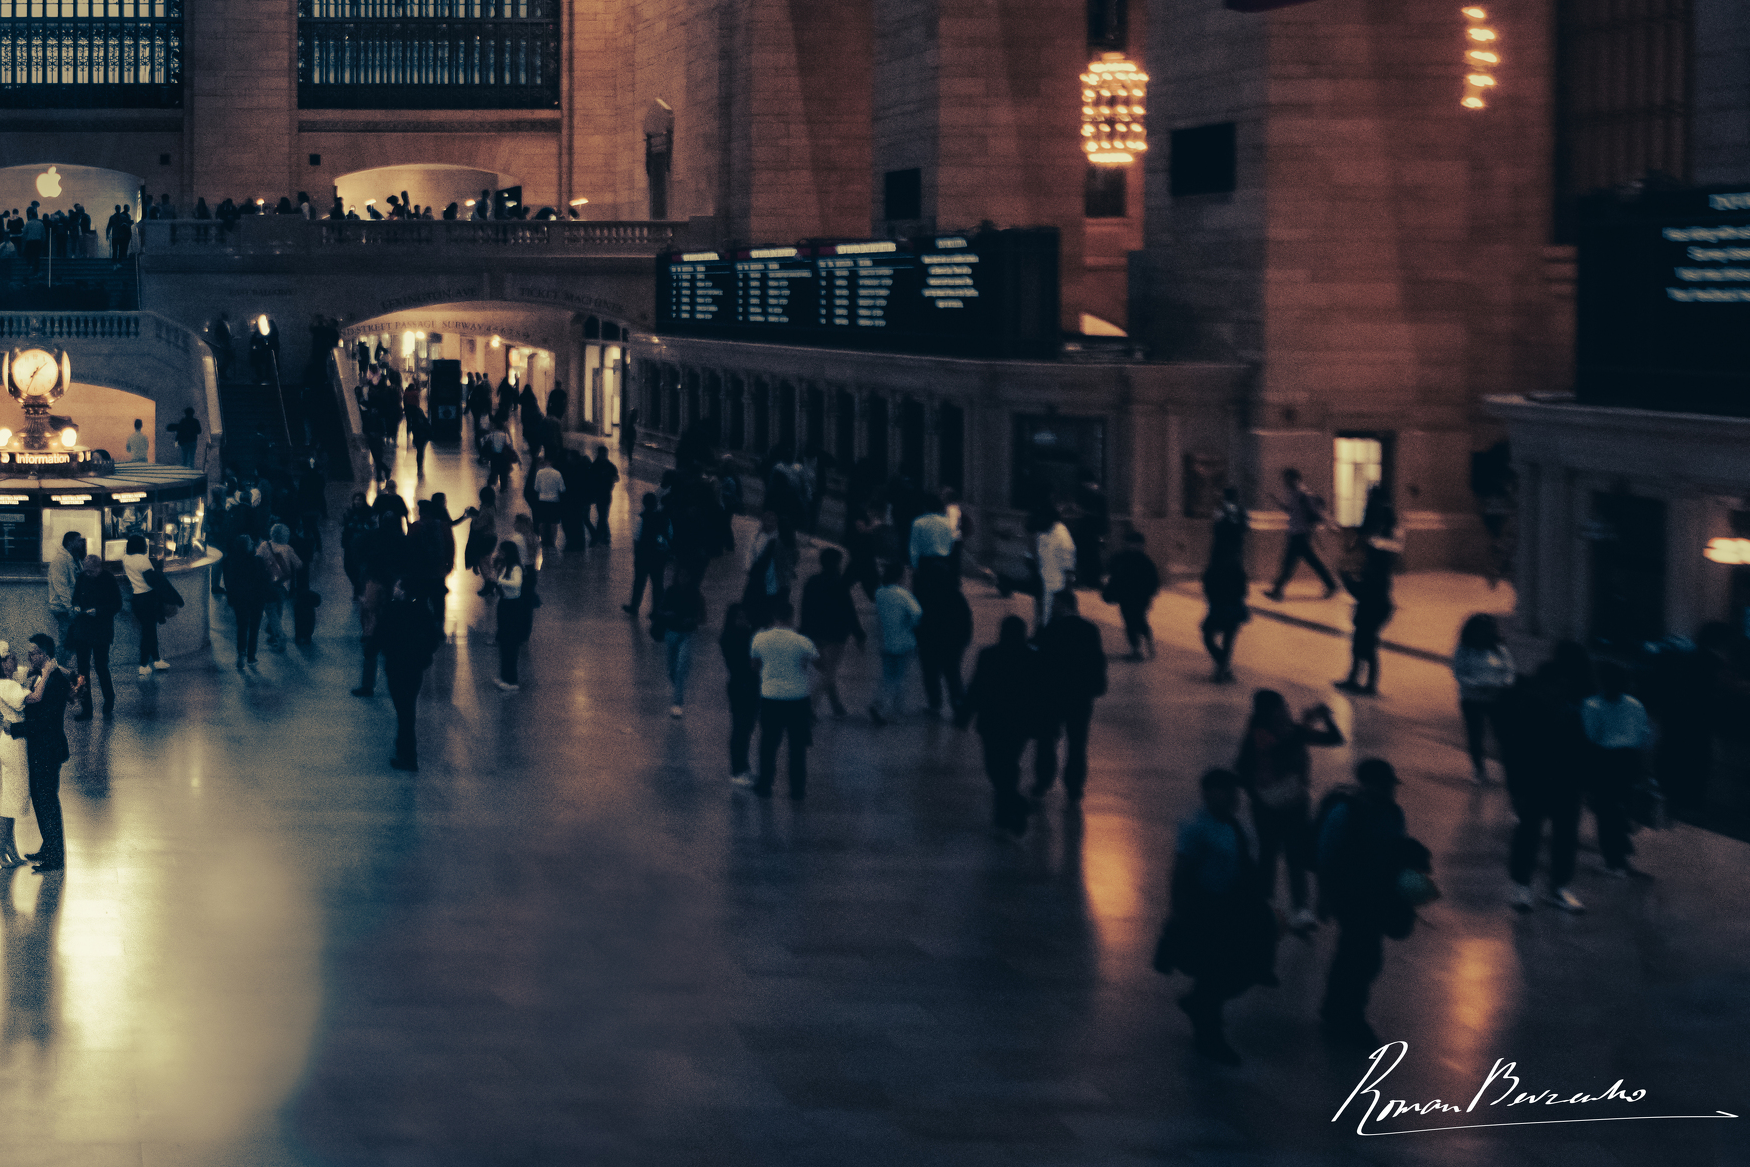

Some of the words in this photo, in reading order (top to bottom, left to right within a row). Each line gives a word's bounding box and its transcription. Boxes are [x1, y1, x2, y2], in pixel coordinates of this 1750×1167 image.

[380, 289, 452, 310] LEXINGTON
[520, 287, 558, 300] TICKET
[564, 291, 624, 313] MACHINES
[355, 322, 391, 334] STREET
[395, 320, 436, 329] PASSAGE
[442, 320, 482, 331] SUBWAY
[15, 453, 70, 464] Information
